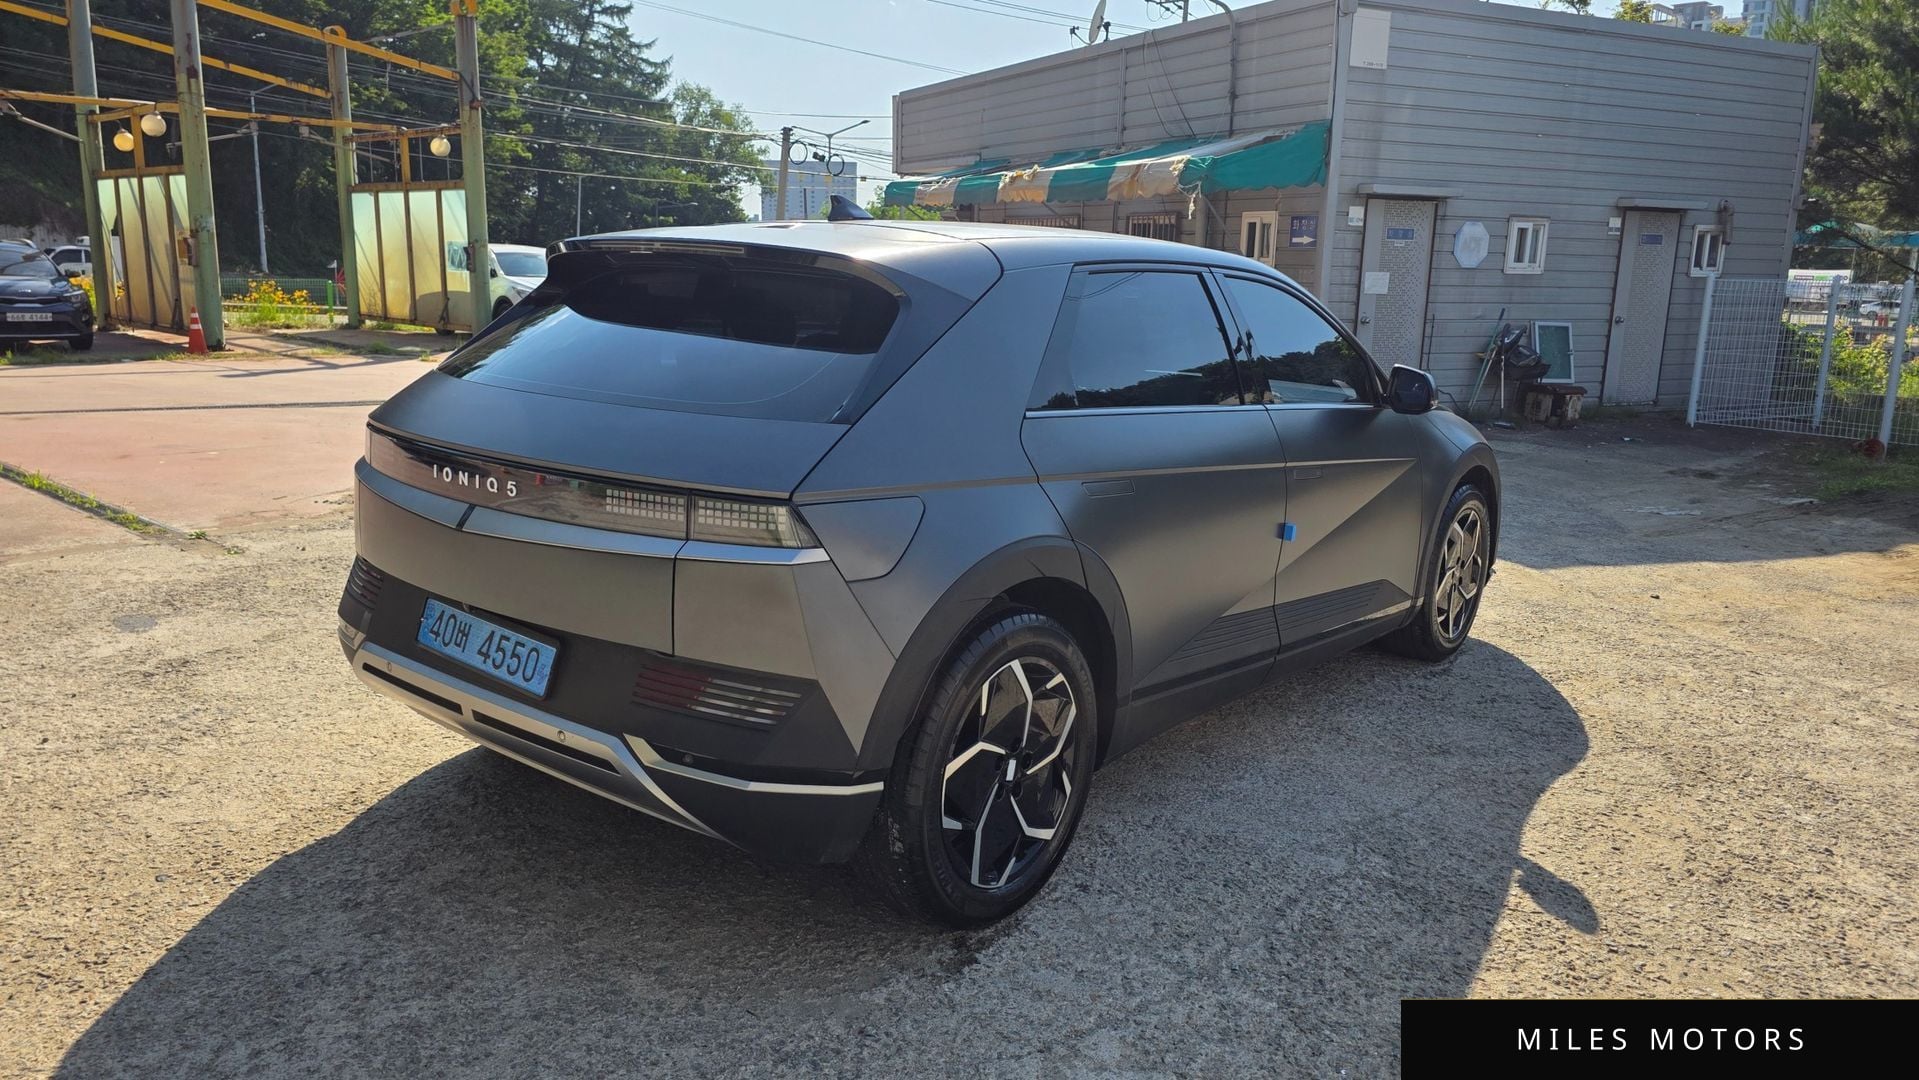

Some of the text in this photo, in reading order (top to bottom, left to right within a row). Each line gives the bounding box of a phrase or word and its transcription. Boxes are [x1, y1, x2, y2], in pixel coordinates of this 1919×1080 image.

[433, 464, 517, 497] IONIQ 5
[429, 610, 540, 683] 40버 4550
